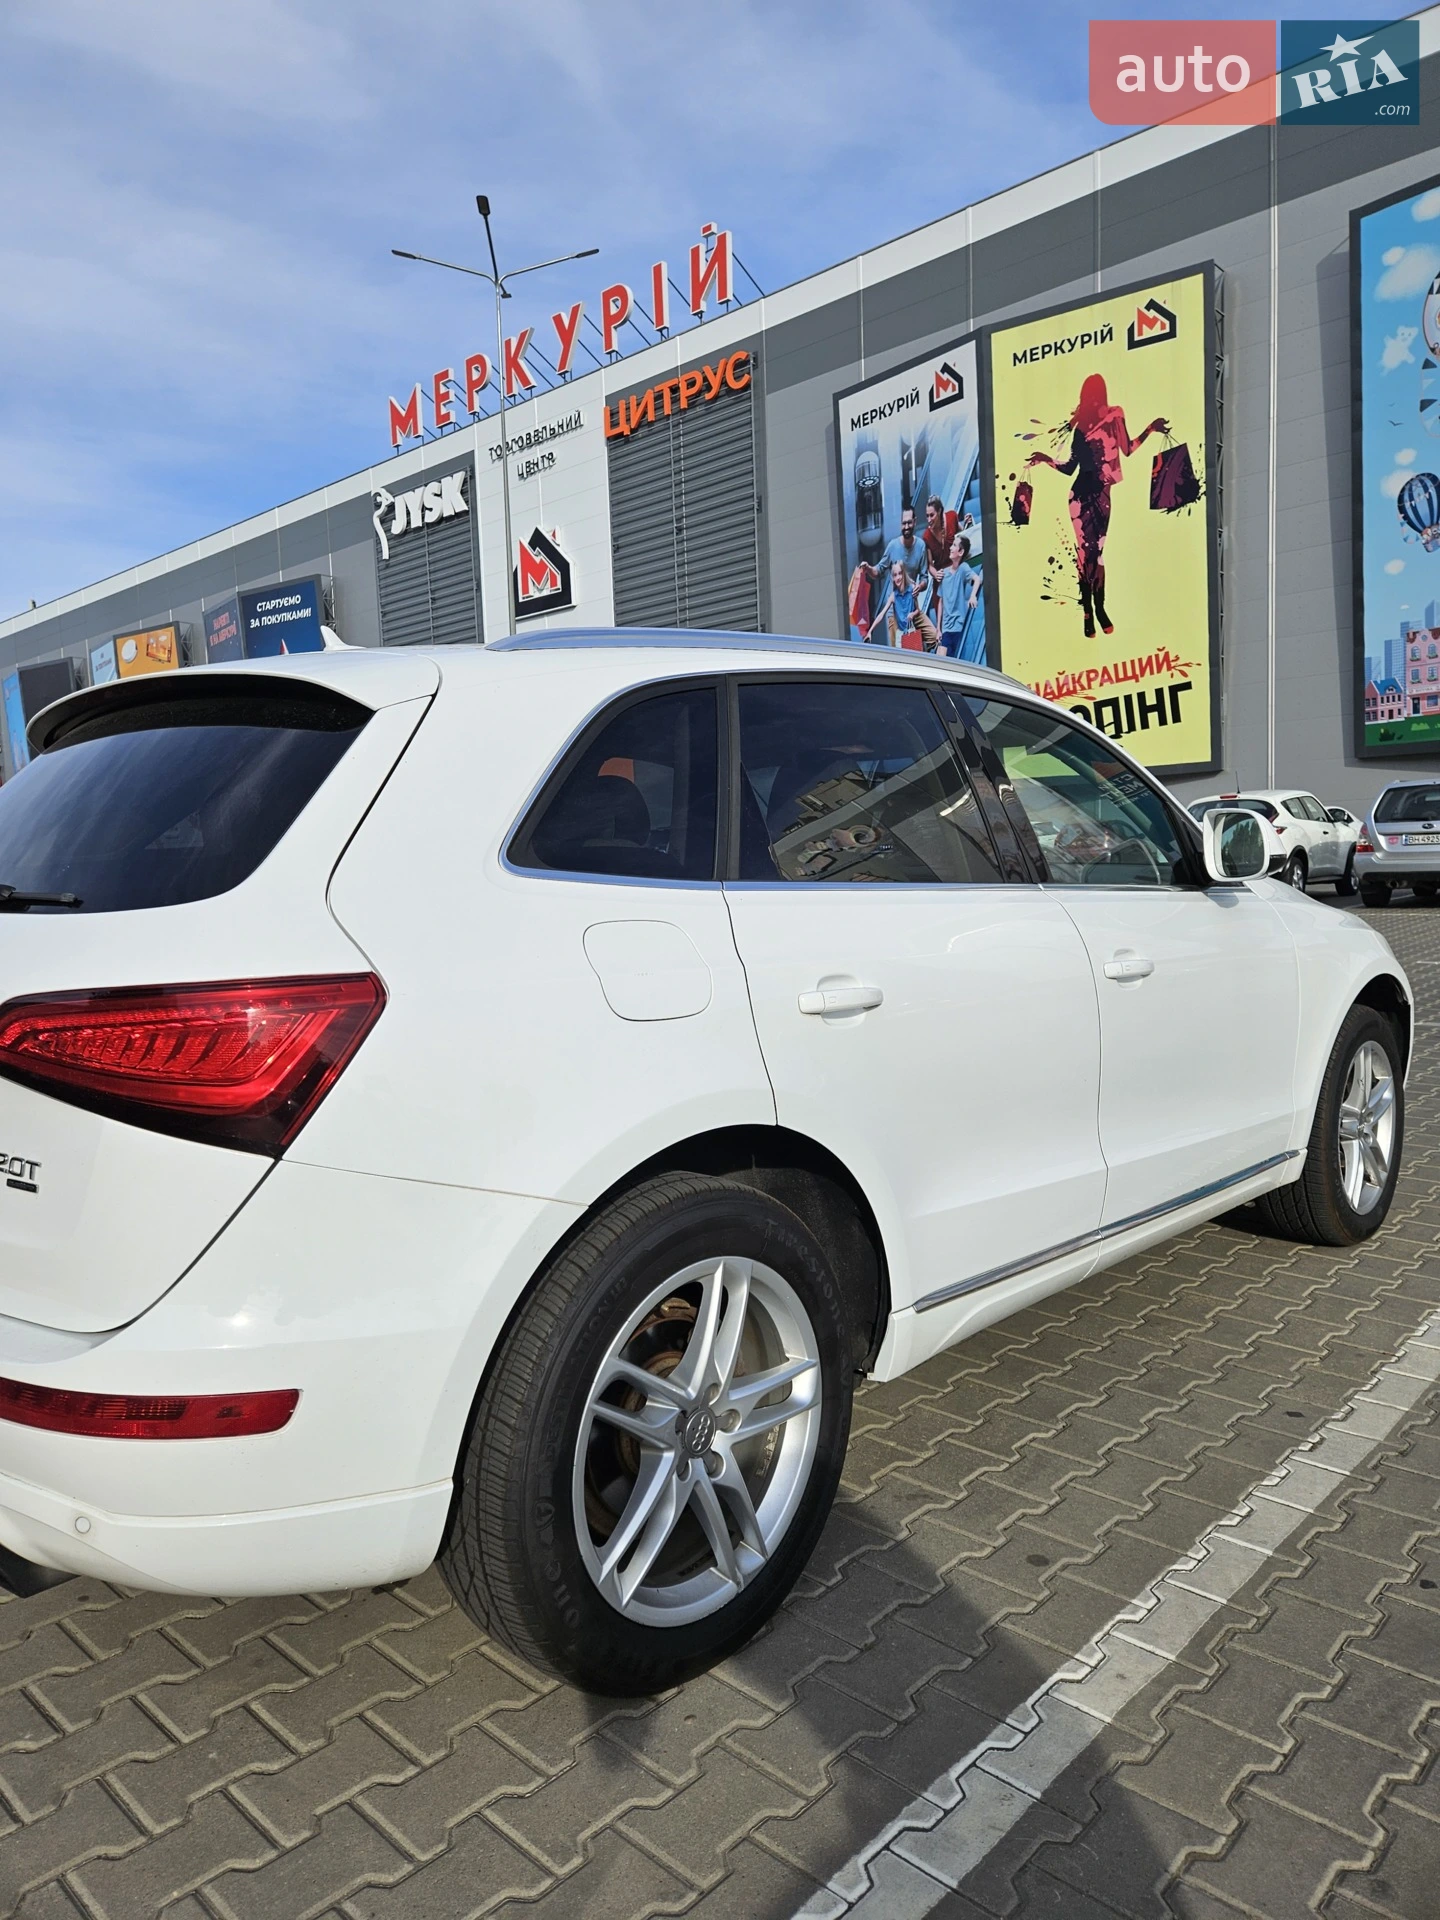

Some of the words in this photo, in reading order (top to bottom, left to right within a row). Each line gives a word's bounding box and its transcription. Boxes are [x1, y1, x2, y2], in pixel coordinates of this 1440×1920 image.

[388, 221, 734, 448] МЕРКУРІЙ
[1012, 323, 1115, 367] МЕРКУРІЙ
[603, 350, 752, 438] ЦИТРУС
[849, 387, 921, 432] МЕРКУРІЙ
[516, 451, 556, 479] ЦЕНТР
[390, 470, 470, 535] JYSK
[249, 617, 261, 629] ЗА
[261, 607, 312, 626] ПОКУПКАМИ!
[256, 594, 302, 613] СТАРТУЄМО
